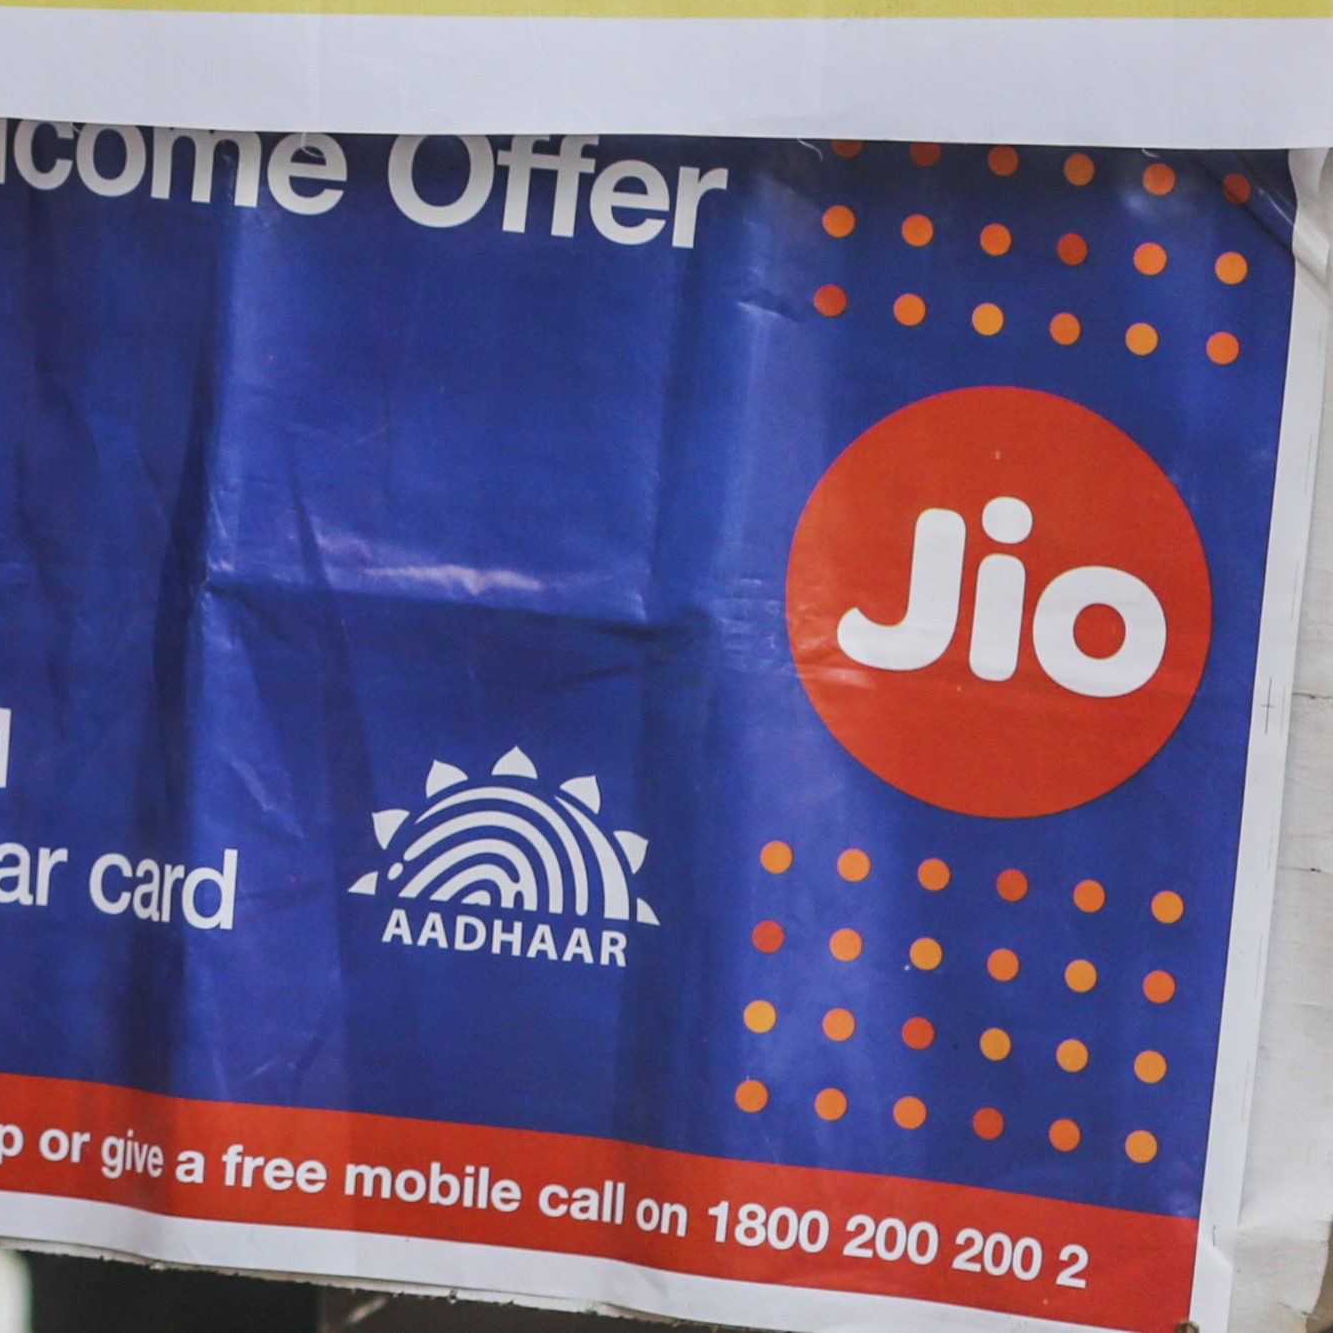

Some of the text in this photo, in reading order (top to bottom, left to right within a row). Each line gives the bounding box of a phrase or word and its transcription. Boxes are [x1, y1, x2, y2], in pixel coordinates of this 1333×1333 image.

[388, 133, 728, 249] Offer
[837, 497, 1166, 697] Jio
[90, 849, 237, 929] card
[381, 908, 627, 967] AADHAAR
[40, 1129, 90, 1162] or
[102, 1130, 163, 1178] give
[176, 1151, 204, 1183] a
[222, 1144, 327, 1192] free
[345, 1162, 521, 1212] mobile
[539, 1181, 625, 1224] call
[637, 1199, 687, 1236] on
[709, 1201, 829, 1252] 1800
[843, 1214, 938, 1264] 200
[952, 1228, 1042, 1280] 200
[1056, 1245, 1088, 1288] 2
